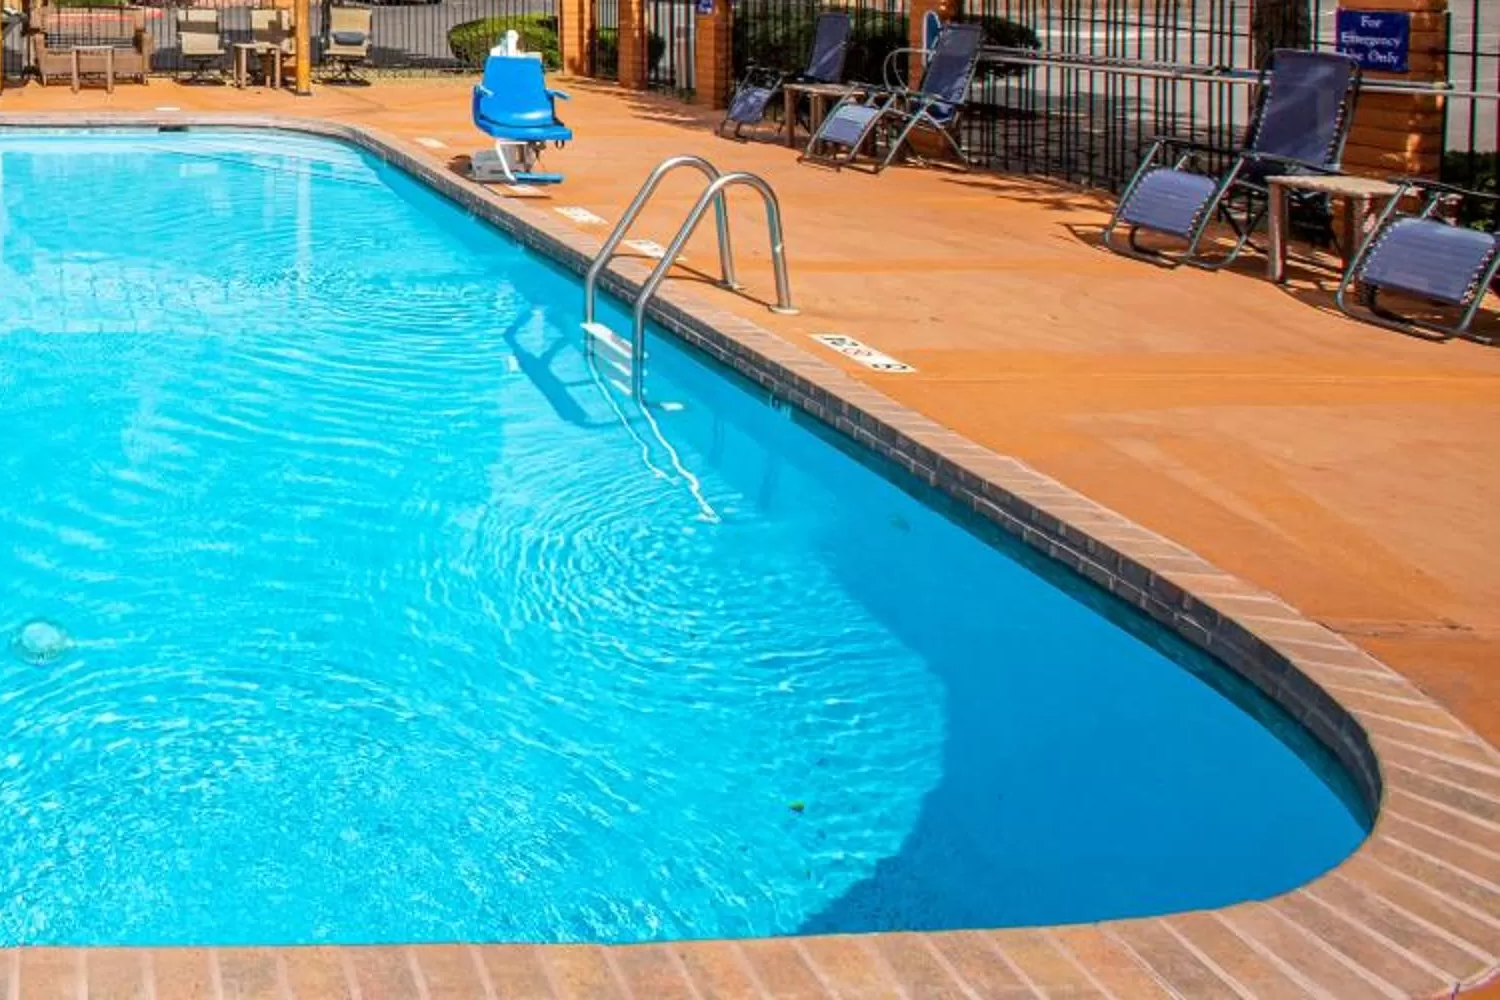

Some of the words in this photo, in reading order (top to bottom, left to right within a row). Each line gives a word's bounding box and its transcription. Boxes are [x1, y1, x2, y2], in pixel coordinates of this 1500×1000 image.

[1360, 15, 1383, 29] For
[1341, 31, 1400, 48] Emergency
[1367, 50, 1399, 65] Only
